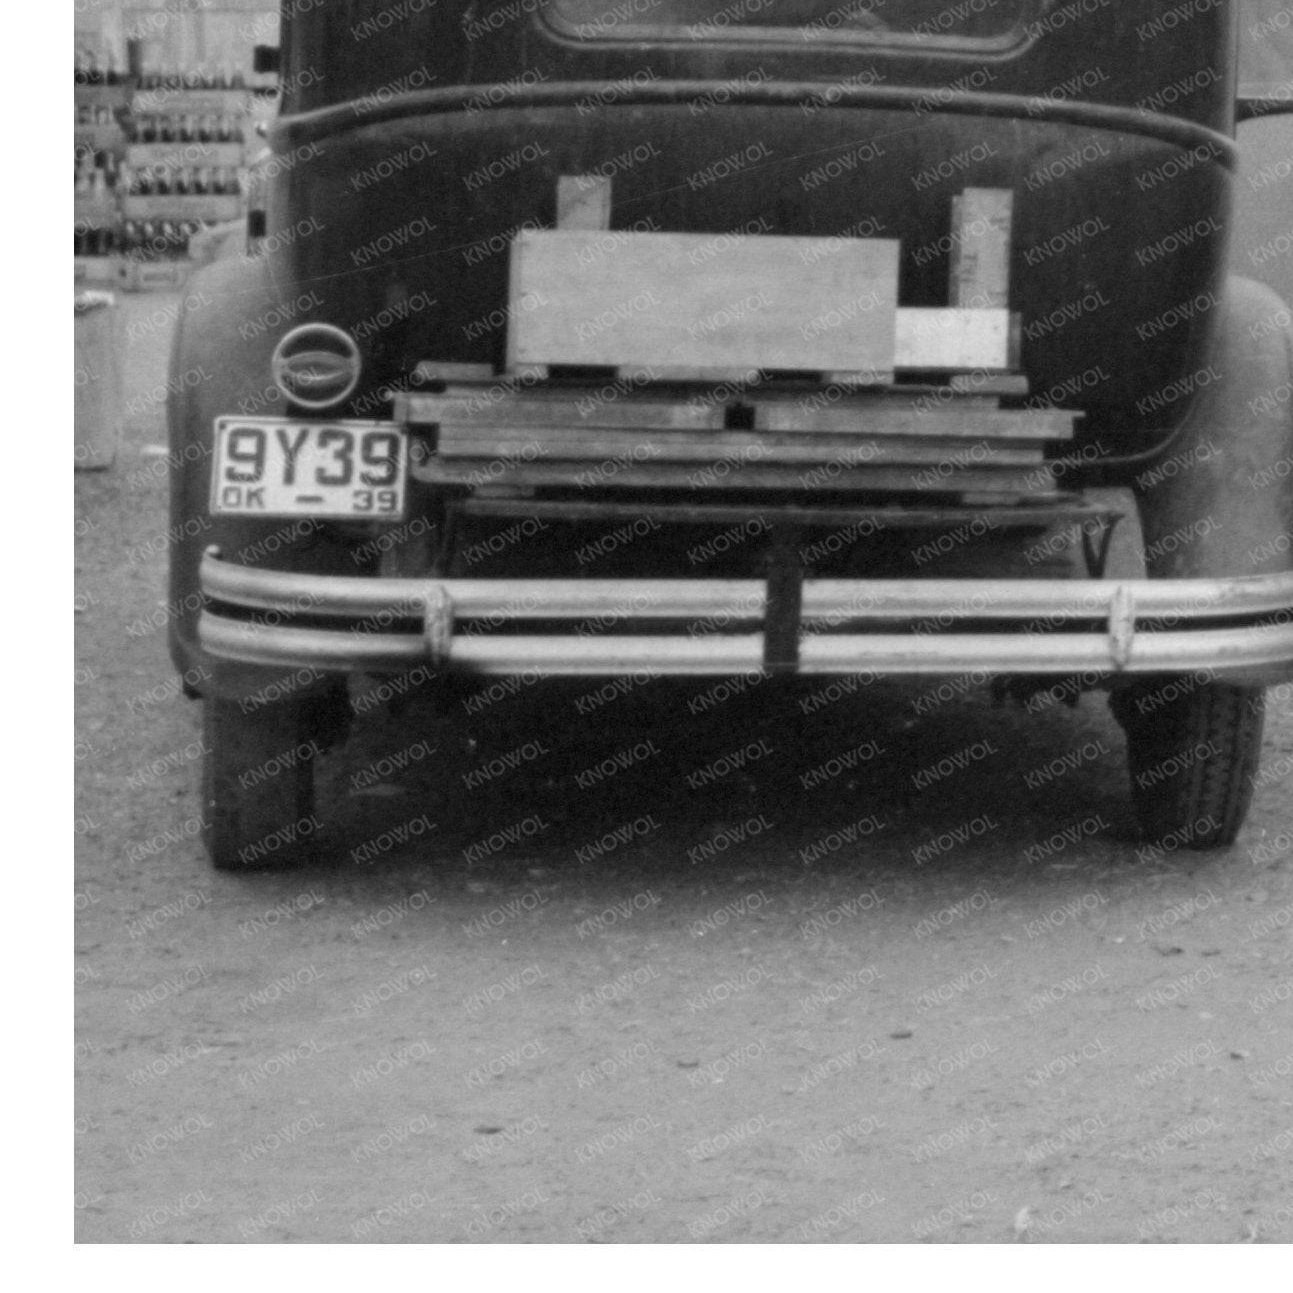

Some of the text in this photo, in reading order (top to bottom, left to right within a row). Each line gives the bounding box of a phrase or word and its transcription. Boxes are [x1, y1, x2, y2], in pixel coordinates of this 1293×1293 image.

[225, 427, 400, 487] 9Y39
[223, 486, 265, 509] OK
[353, 490, 396, 511] 39
